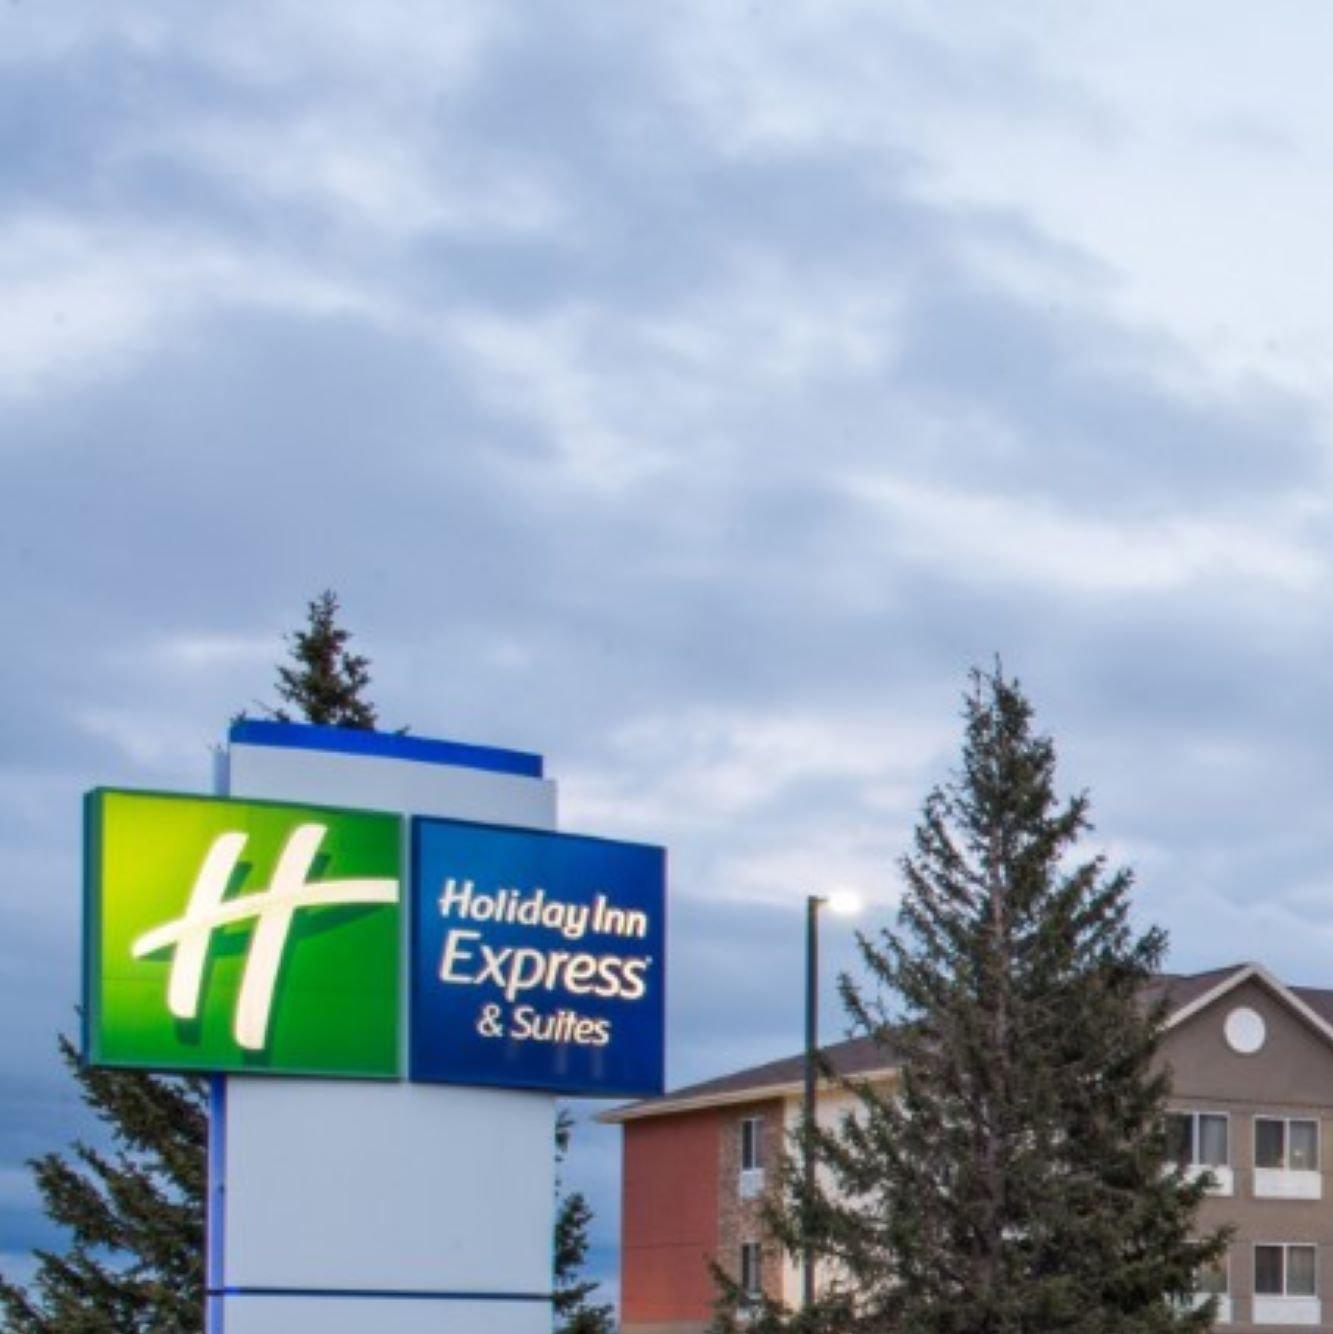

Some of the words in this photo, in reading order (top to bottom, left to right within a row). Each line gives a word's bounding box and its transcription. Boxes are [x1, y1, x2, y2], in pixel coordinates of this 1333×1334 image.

[439, 877, 589, 941] Holiday
[591, 892, 648, 939] Inn
[439, 928, 648, 1002] Express
[476, 1001, 504, 1039] &
[510, 1004, 611, 1047] Suites
